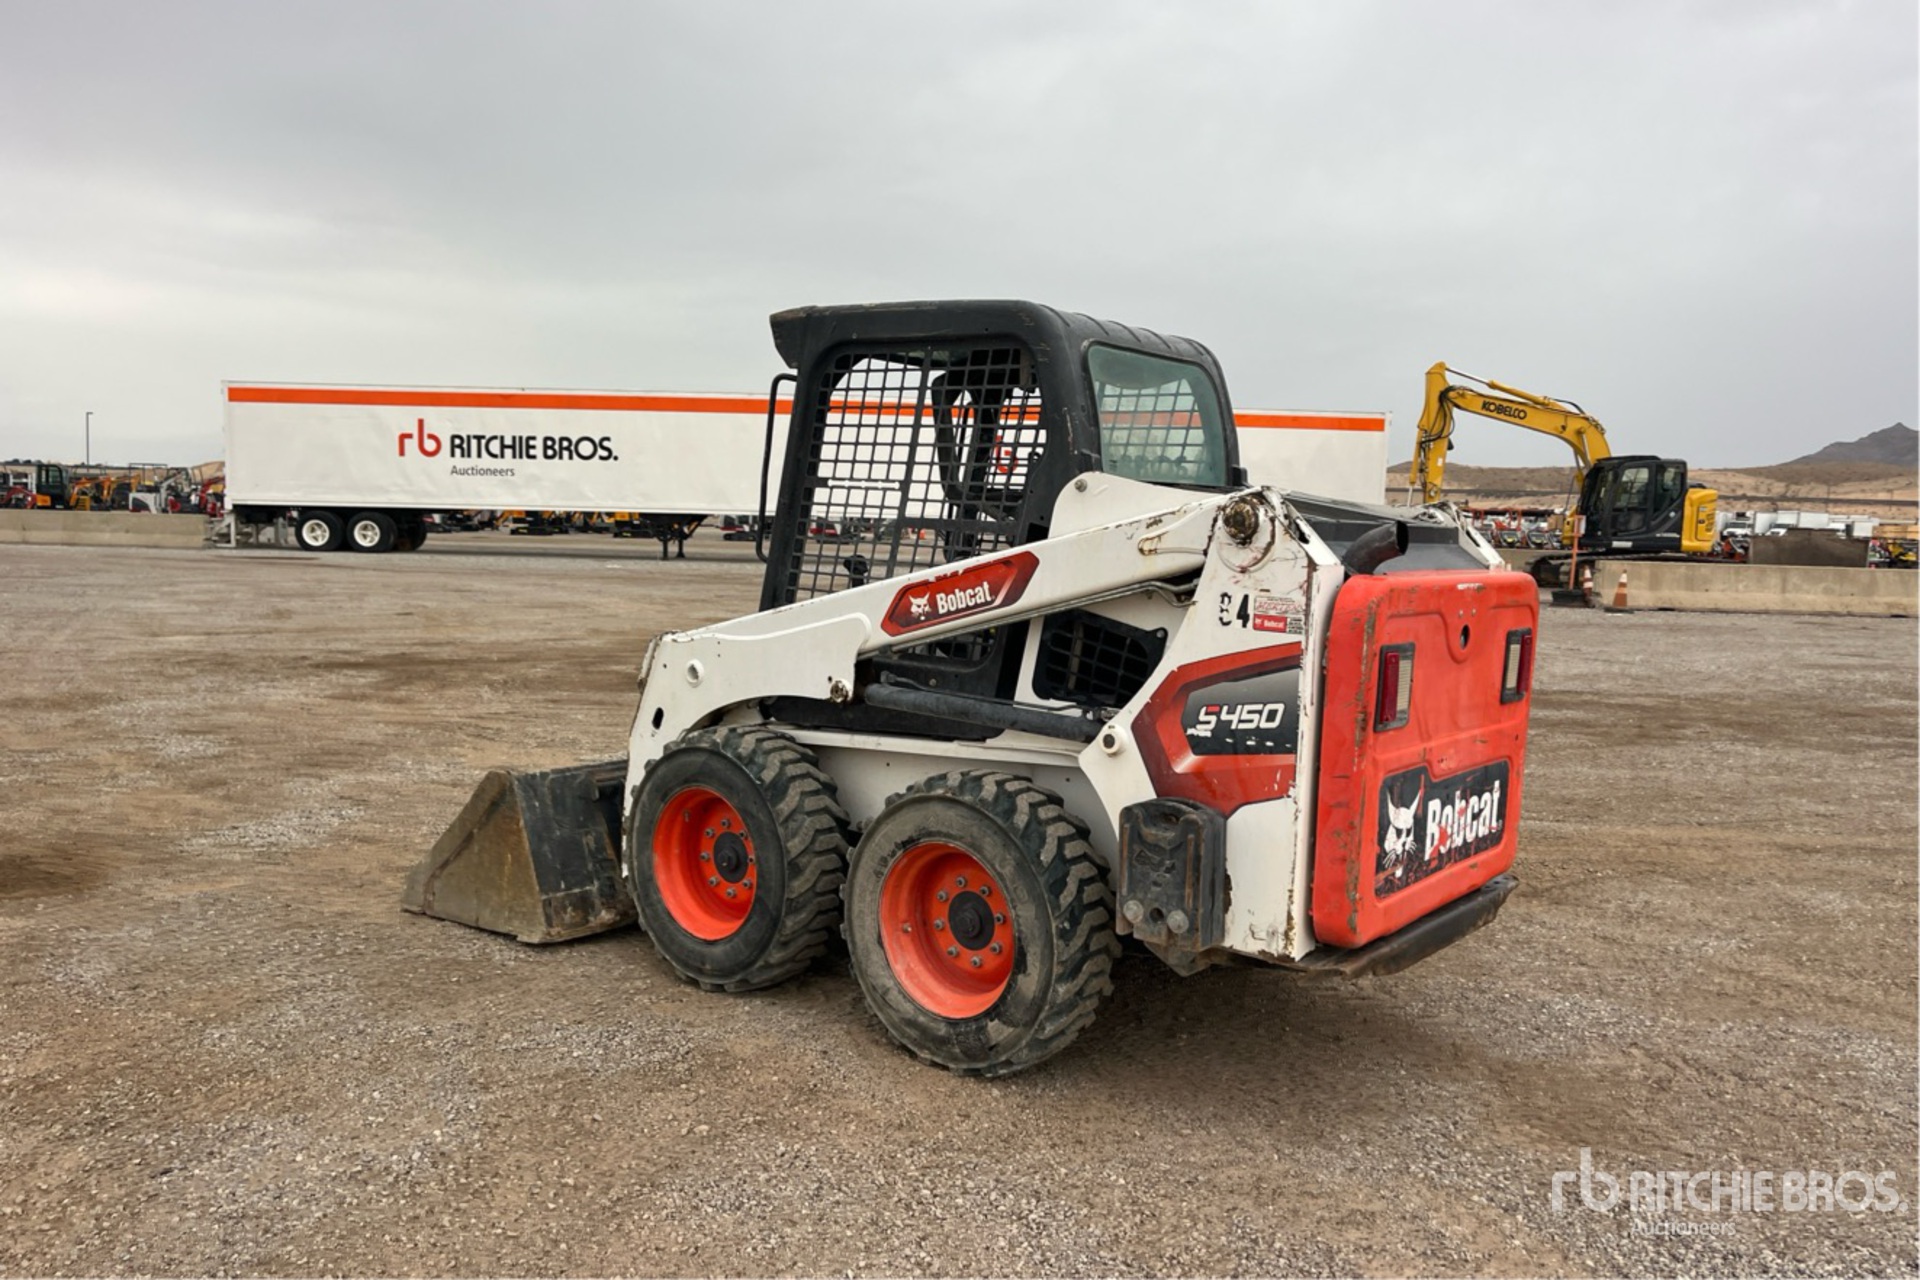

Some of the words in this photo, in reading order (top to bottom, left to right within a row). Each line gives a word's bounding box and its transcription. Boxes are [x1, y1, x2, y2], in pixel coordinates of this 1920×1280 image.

[1481, 400, 1527, 420] KOBELCO
[398, 418, 442, 457] rb
[450, 434, 537, 460] RITCHIE
[542, 436, 619, 461] BROS.
[450, 465, 516, 477] Auctioneers
[936, 581, 991, 614] Bobcat
[1195, 703, 1285, 731] S450
[1424, 779, 1501, 861] Bobcat
